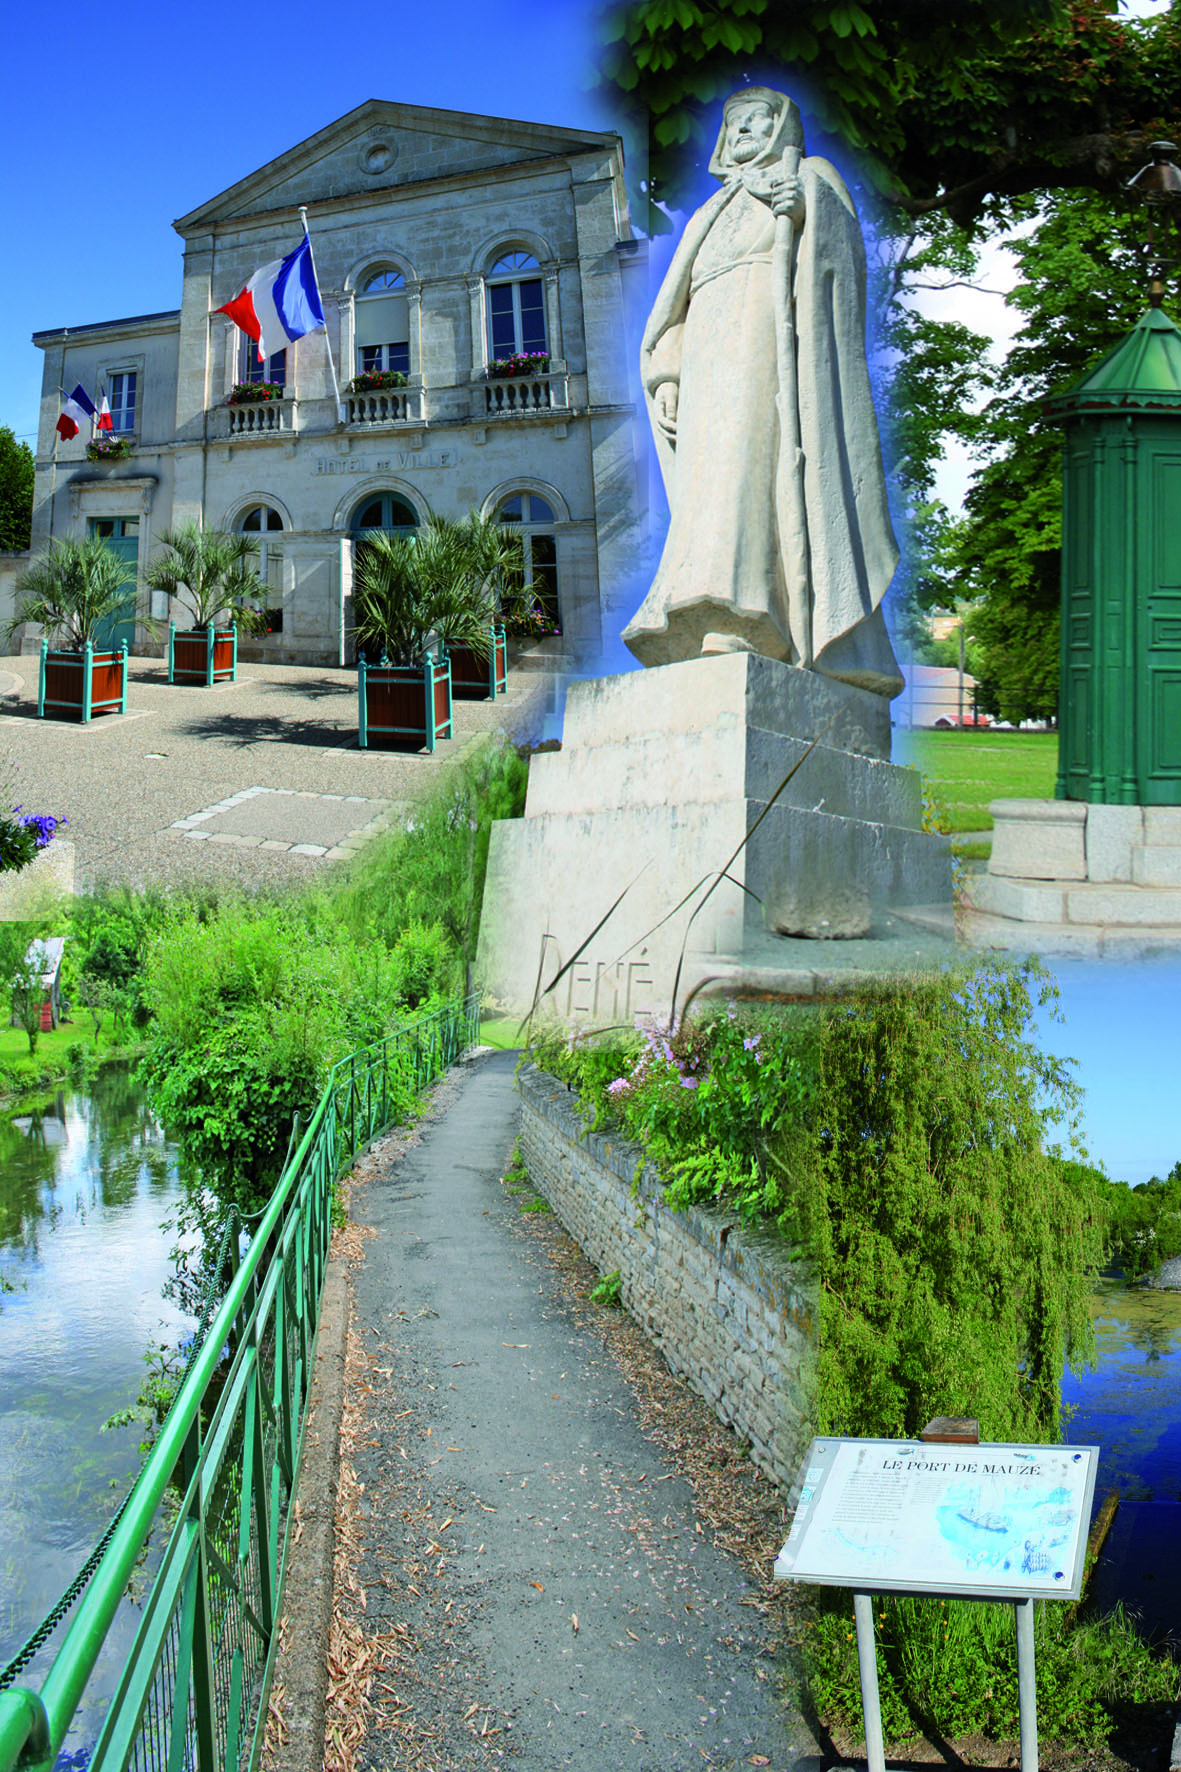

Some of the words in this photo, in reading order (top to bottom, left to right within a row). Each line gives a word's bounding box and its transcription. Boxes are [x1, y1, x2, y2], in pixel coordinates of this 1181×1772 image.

[399, 452, 450, 471] VILLE
[882, 1460, 903, 1470] LE
[907, 1461, 951, 1472] PORT
[954, 1462, 978, 1473] DE
[982, 1463, 1041, 1476] MAUZÉ
